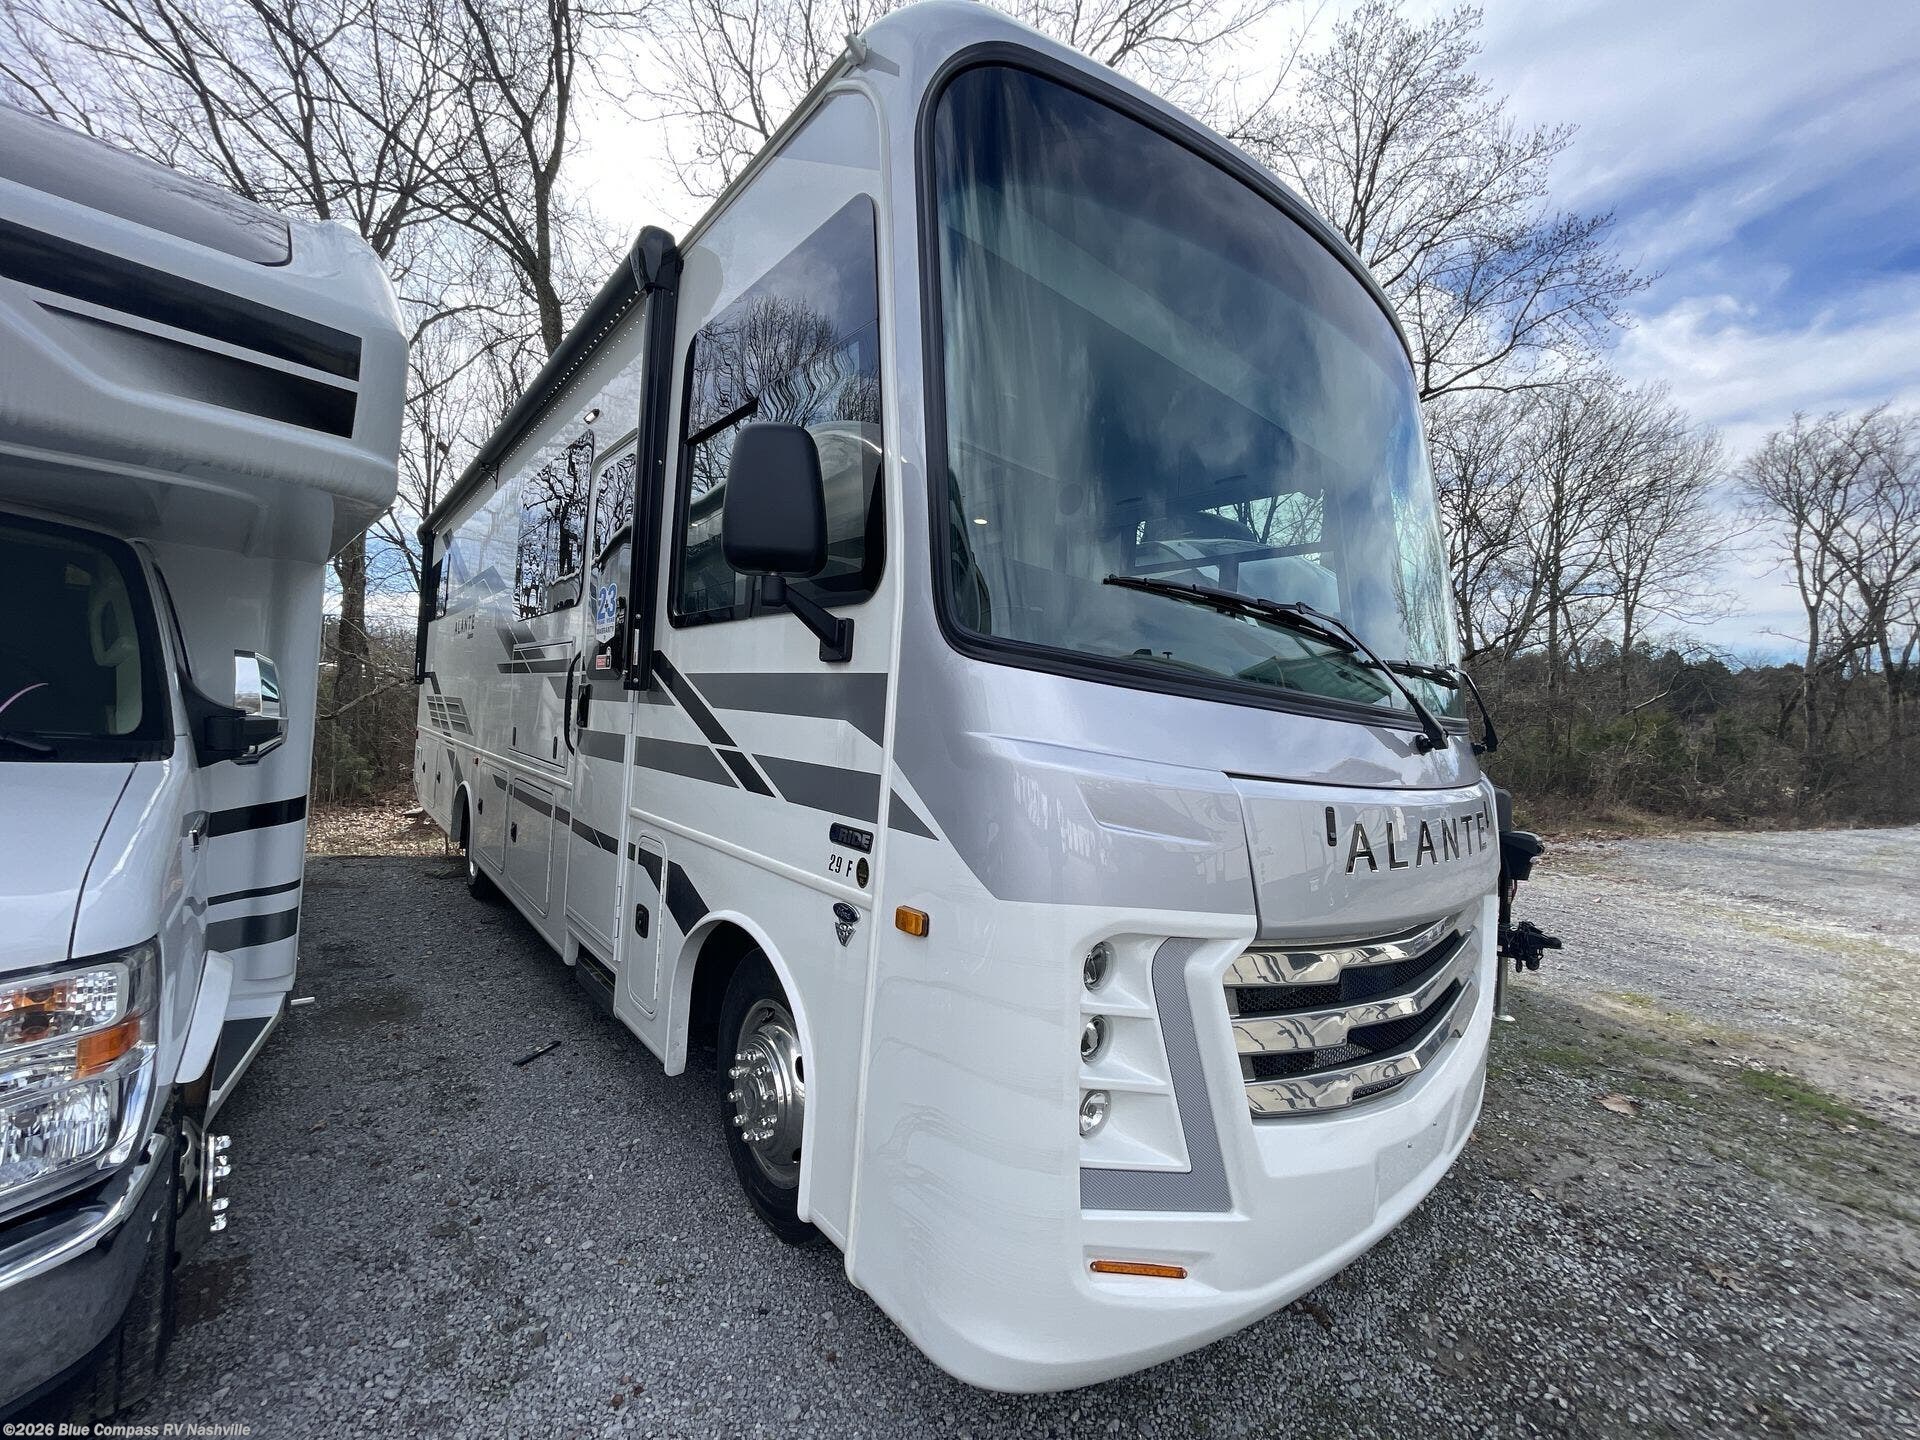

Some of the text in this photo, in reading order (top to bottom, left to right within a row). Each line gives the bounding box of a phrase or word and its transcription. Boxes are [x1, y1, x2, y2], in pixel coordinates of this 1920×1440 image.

[828, 853, 843, 873] 29
[846, 860, 853, 877] F
[1345, 811, 1488, 875] ALANTE
